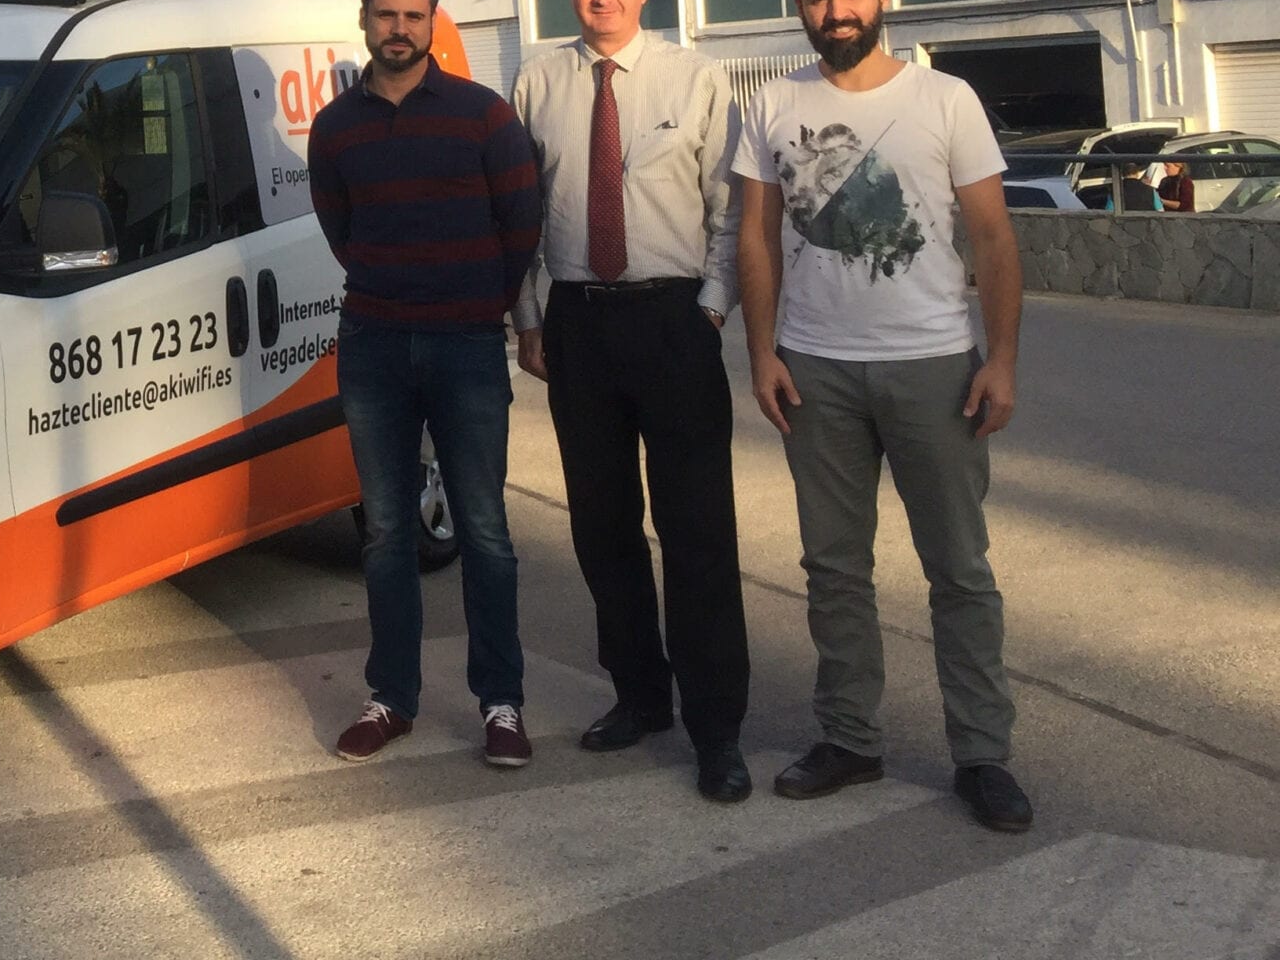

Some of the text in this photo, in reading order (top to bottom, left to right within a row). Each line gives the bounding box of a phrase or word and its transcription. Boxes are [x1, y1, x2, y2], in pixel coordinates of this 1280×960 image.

[271, 167, 283, 185] El
[280, 294, 336, 325] Internet
[48, 311, 219, 384] 868 17 23 23
[28, 365, 233, 436] haztecliente@akiwifi.es
